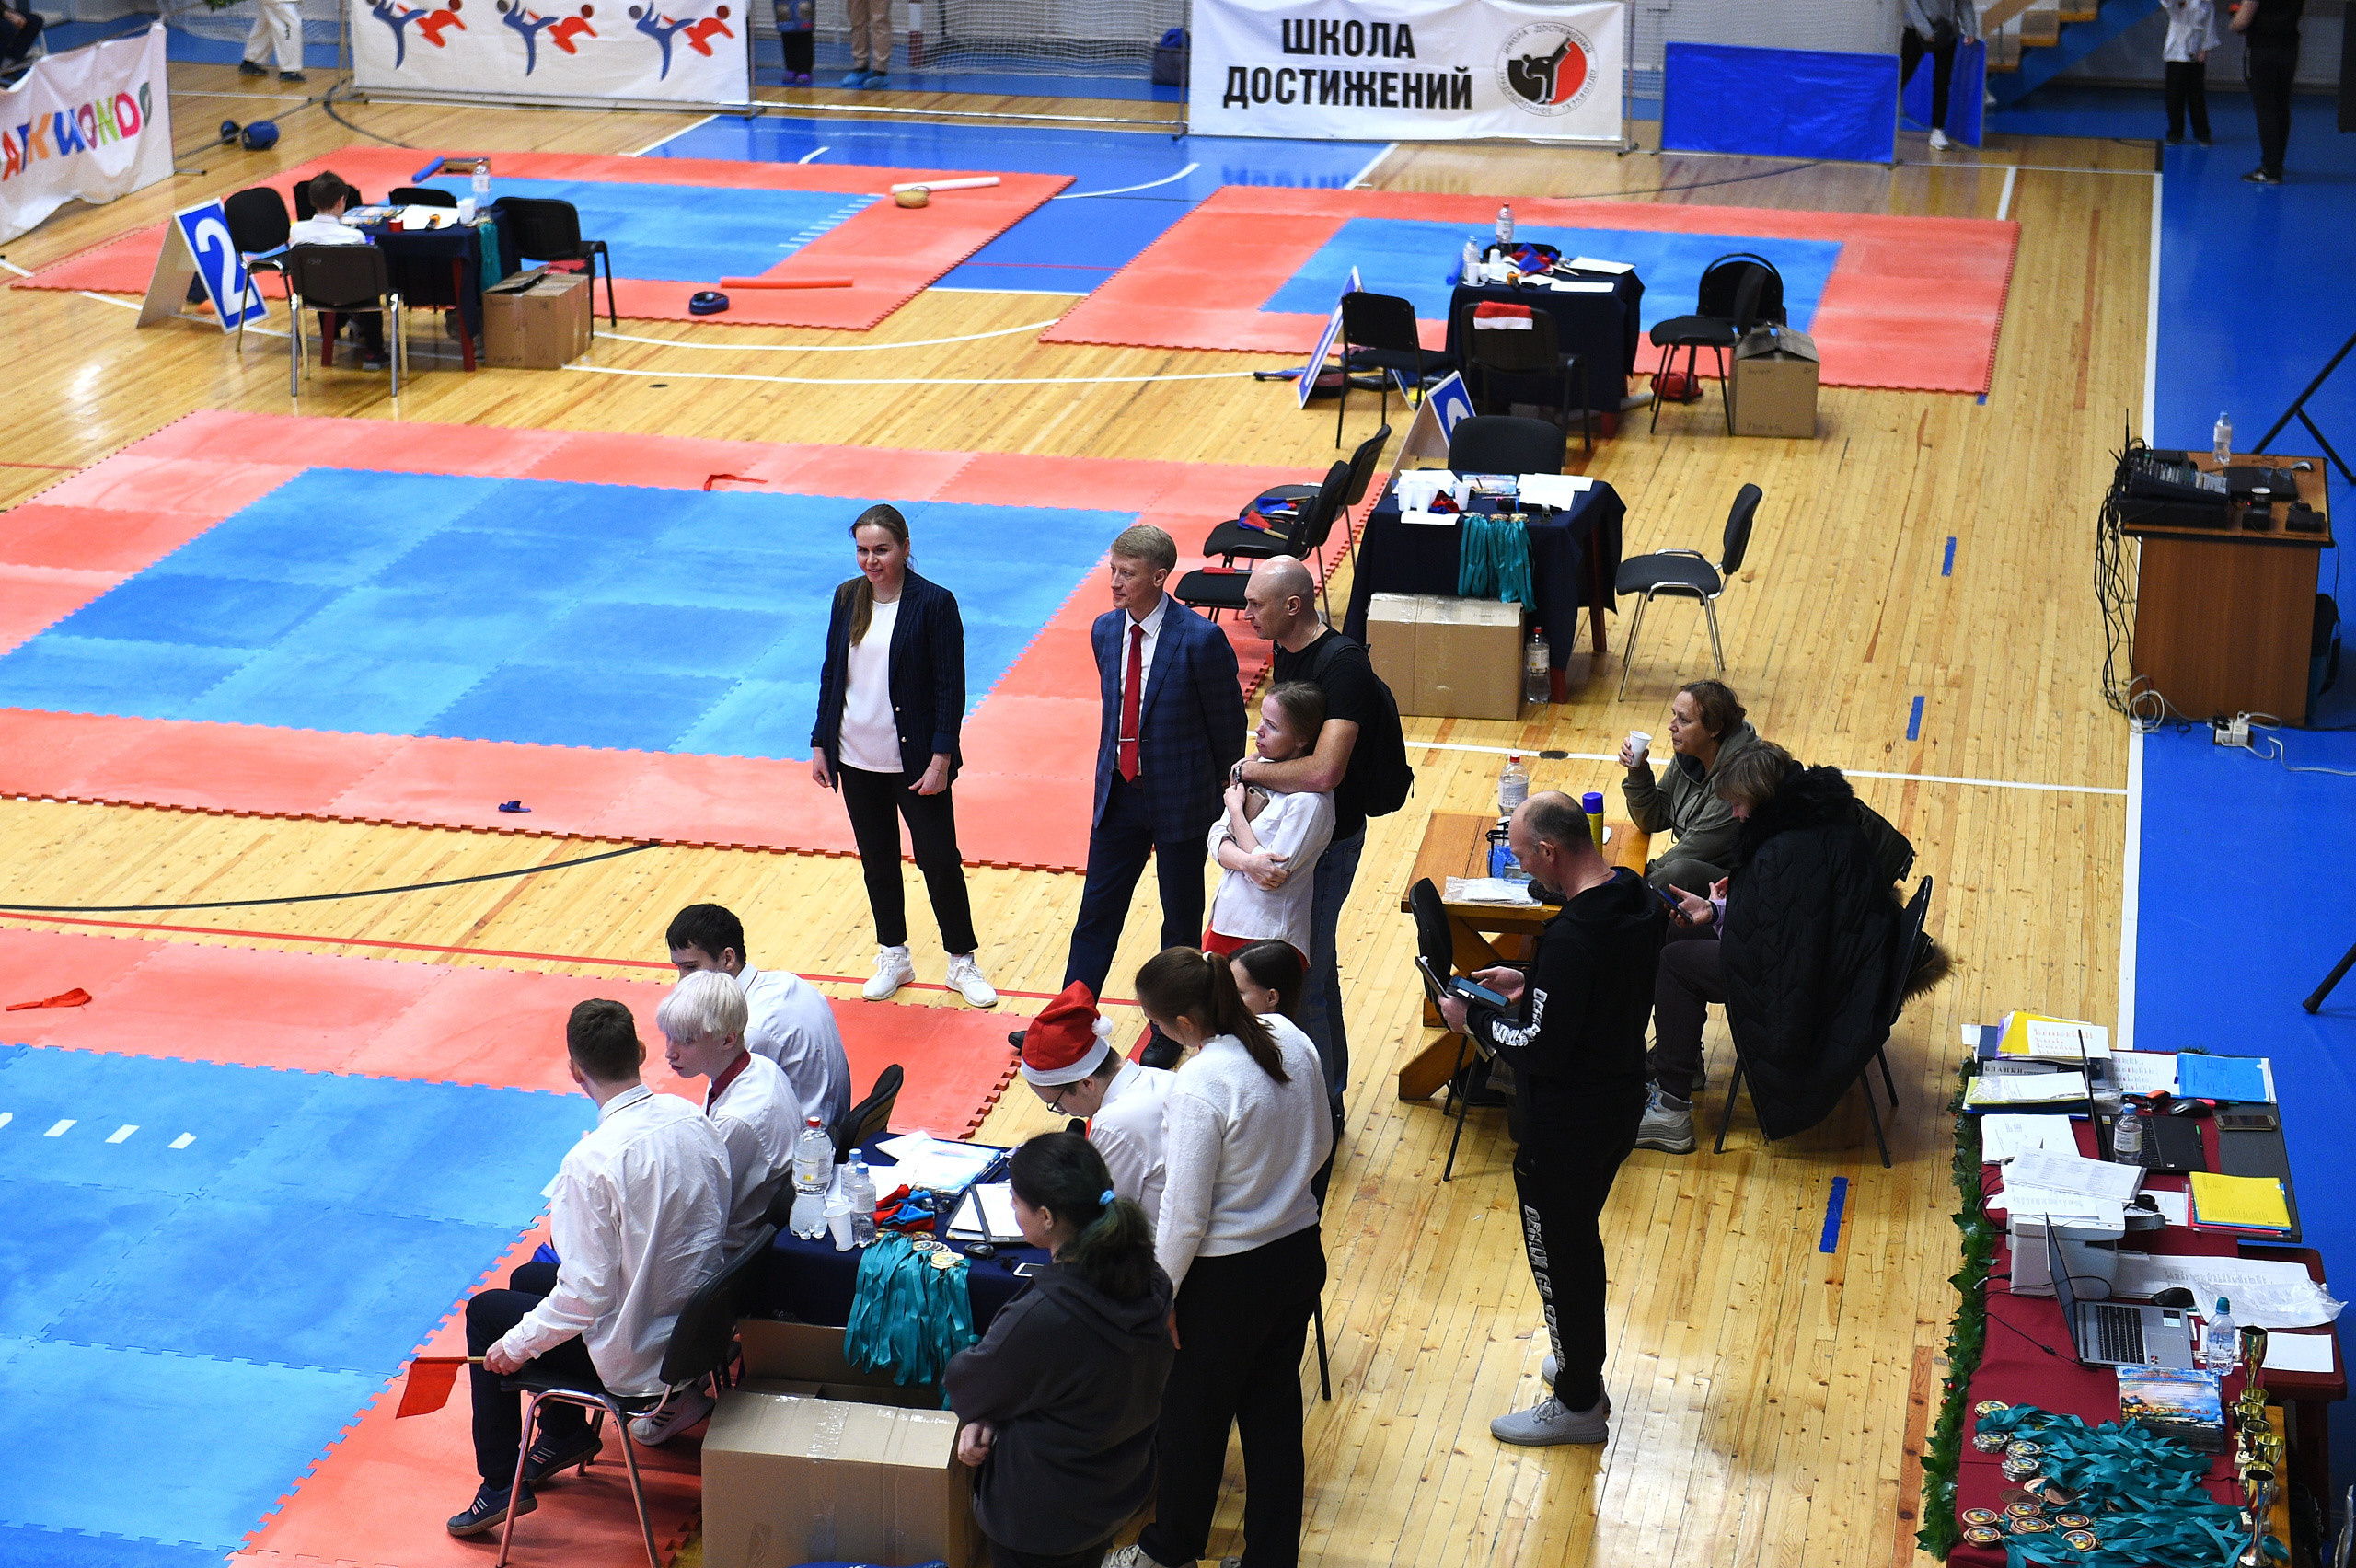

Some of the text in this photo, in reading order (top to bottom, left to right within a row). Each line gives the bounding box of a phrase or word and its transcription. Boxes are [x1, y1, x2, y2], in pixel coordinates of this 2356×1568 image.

[1282, 18, 1415, 59] ШКОЛА
[1502, 29, 1529, 55] ШКОЛА
[1223, 65, 1472, 110] ДОСТИЖЕНИЙ
[195, 217, 259, 317] 2
[1984, 1065, 2024, 1076] БЛАНКИ
[2137, 1405, 2211, 1416] ГРАМОТА
